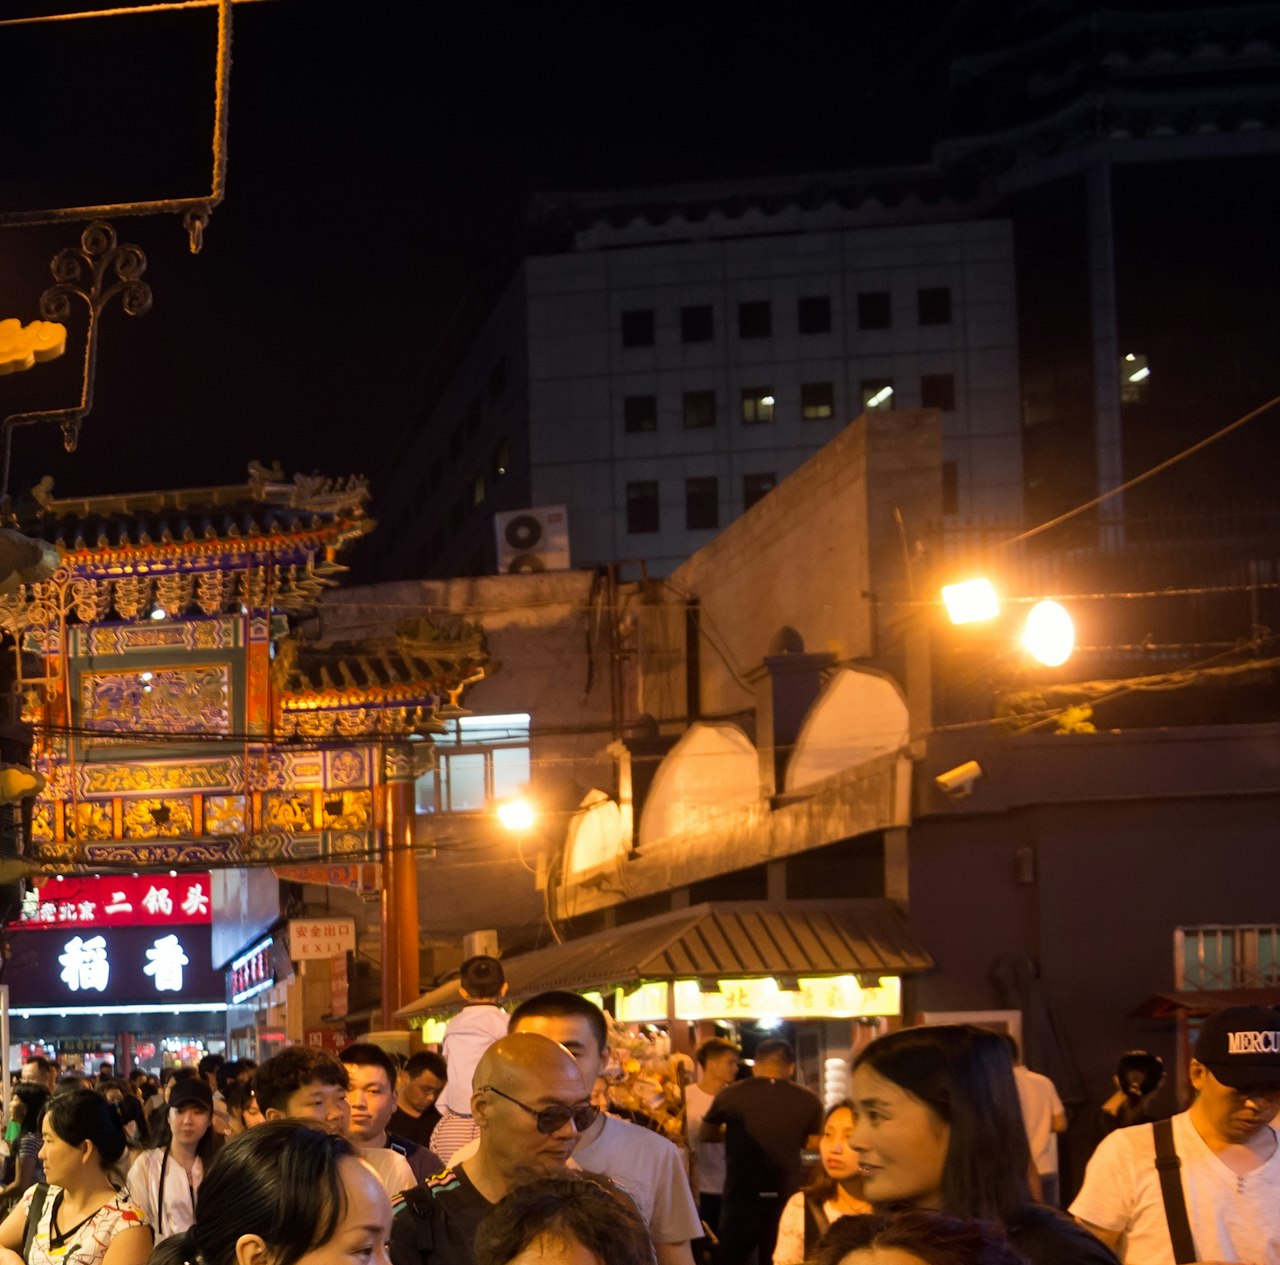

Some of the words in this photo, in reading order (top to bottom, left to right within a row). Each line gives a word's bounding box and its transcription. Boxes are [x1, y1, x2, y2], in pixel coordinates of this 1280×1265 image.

[104, 882, 210, 917] 二锅头
[296, 924, 350, 939] 安全出口
[302, 942, 343, 953] EXIT
[57, 933, 190, 993] 稻香
[1227, 1031, 1280, 1054] MERCU
